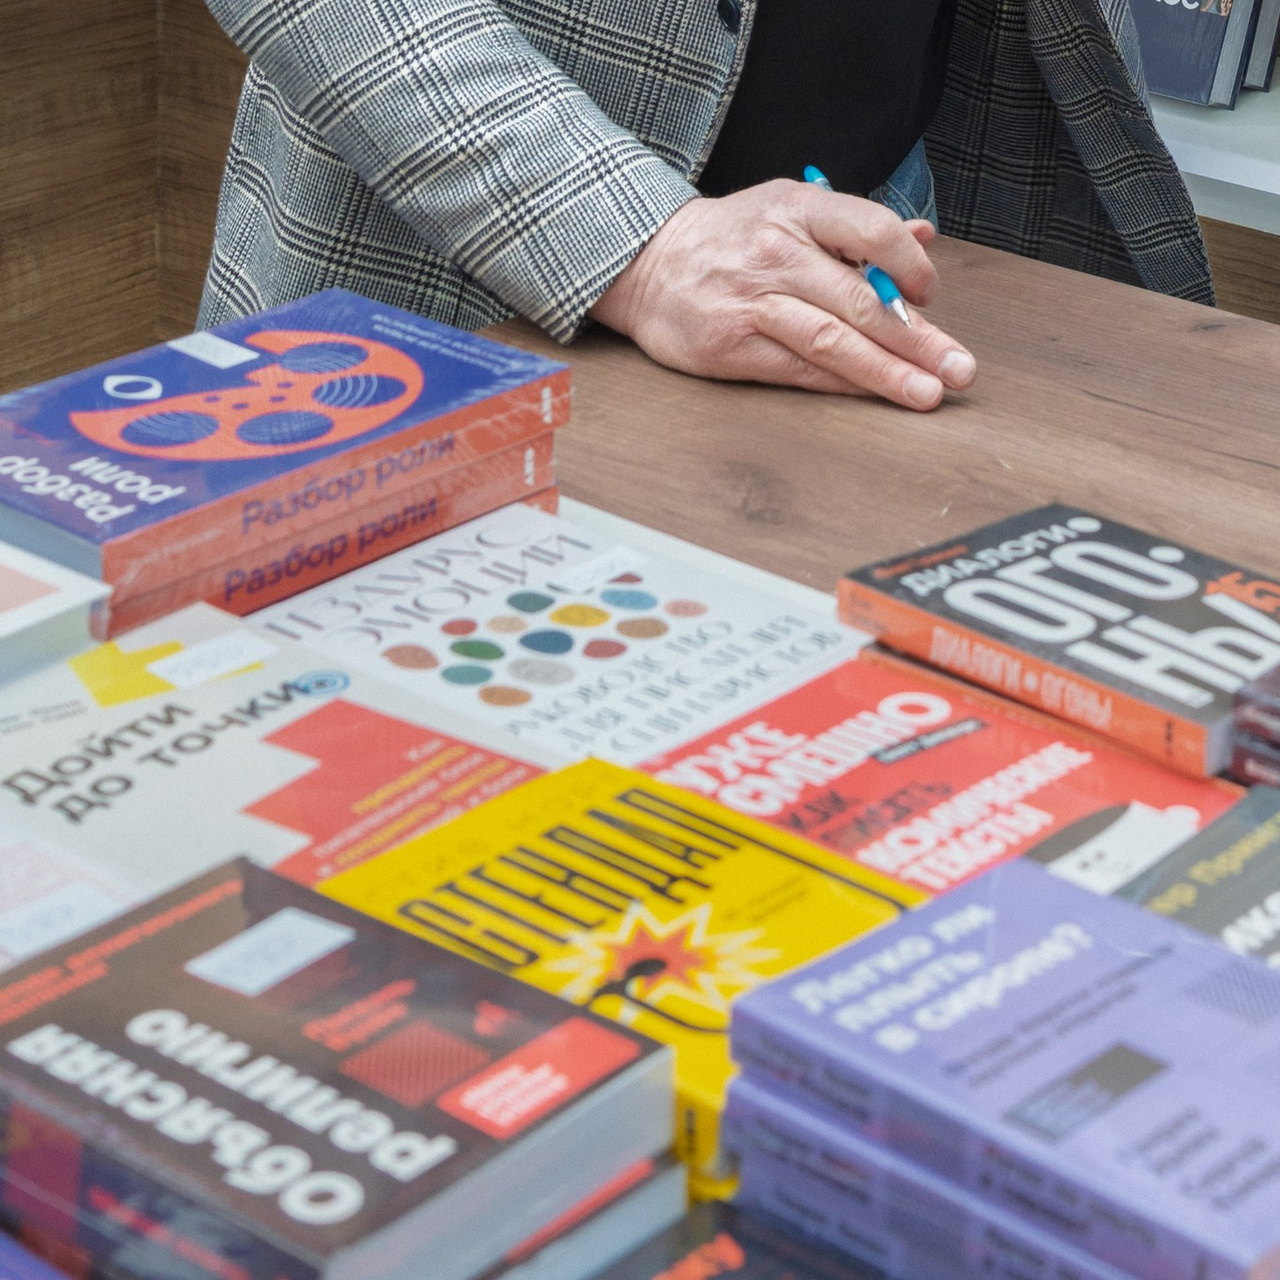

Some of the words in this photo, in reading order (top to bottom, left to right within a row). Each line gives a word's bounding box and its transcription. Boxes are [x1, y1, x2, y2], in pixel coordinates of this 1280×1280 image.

[0, 453, 136, 525] Разбор
[68, 454, 187, 507] роли
[241, 467, 367, 537] Разбор
[374, 429, 456, 485] роли
[223, 533, 349, 603] Разбор
[356, 495, 439, 554] роли
[899, 518, 1080, 598] ДИАЛОГИ
[0, 699, 194, 805] Дойти
[54, 771, 135, 823] до
[142, 674, 312, 773] точки
[705, 682, 966, 823] СМЕШНО
[396, 785, 790, 975] СТЕНДАП
[5, 1023, 366, 1226] Объясняя
[125, 1008, 458, 1184] религию
